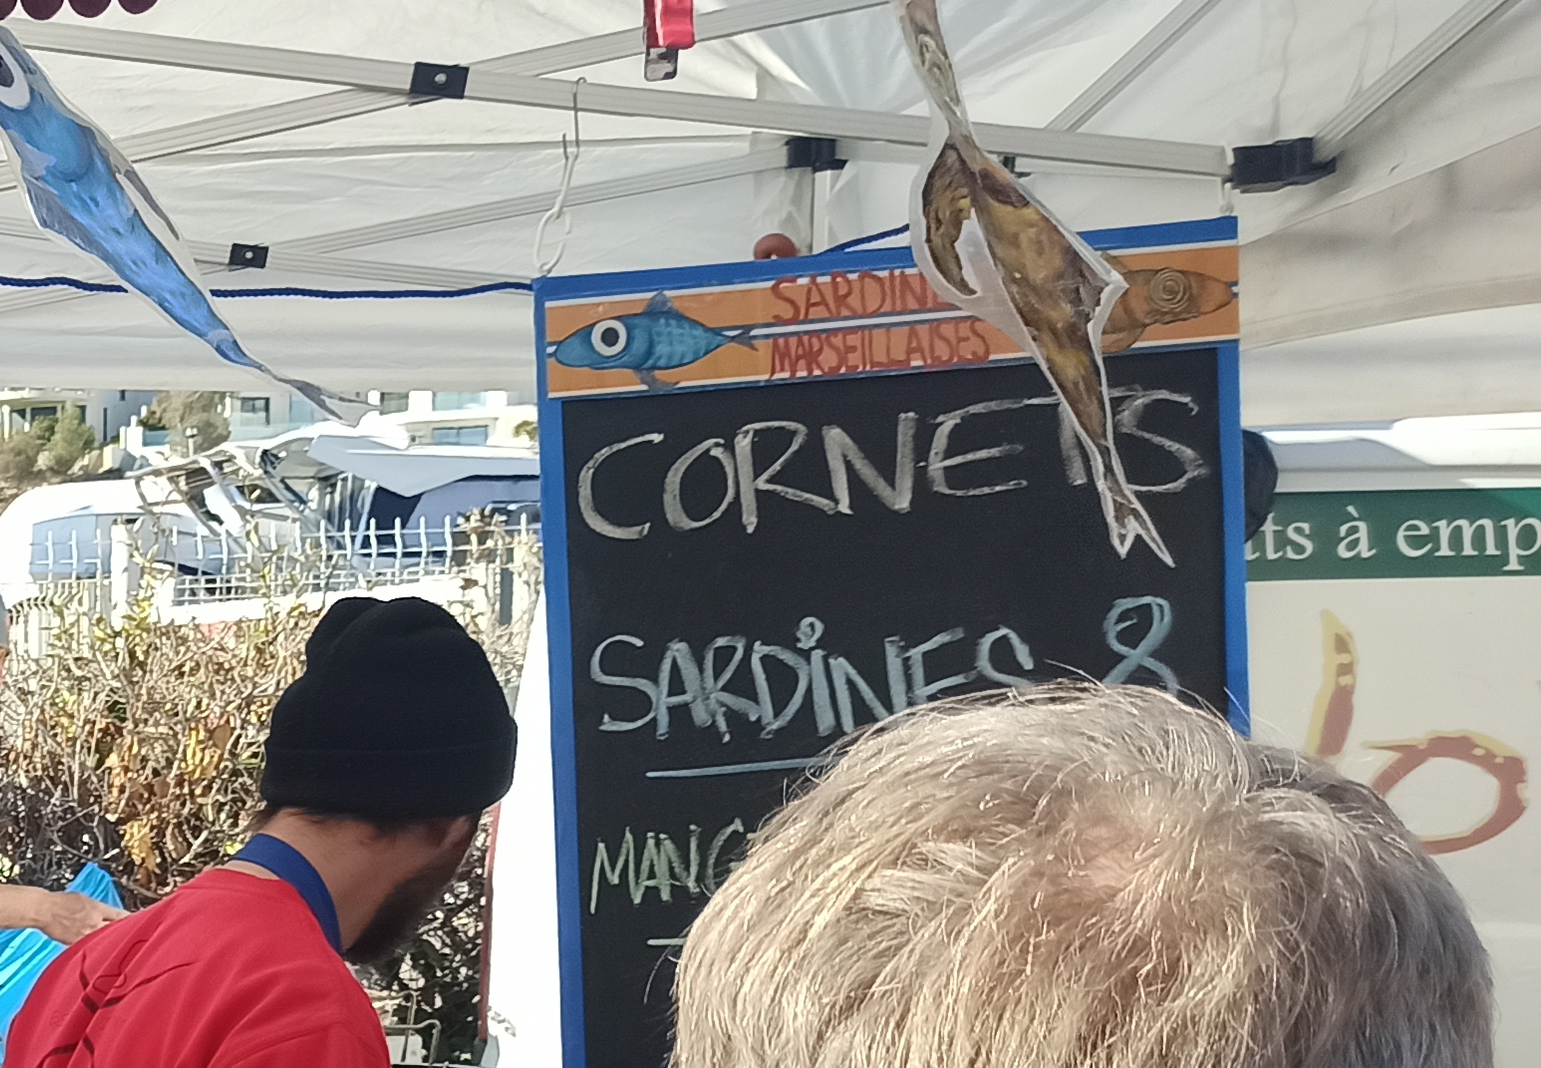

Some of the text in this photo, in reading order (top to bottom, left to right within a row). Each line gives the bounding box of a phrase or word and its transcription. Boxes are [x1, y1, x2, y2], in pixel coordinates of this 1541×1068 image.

[769, 320, 991, 380] MARSEILLAISES
[1244, 511, 1315, 562] ts
[1336, 504, 1377, 560] à
